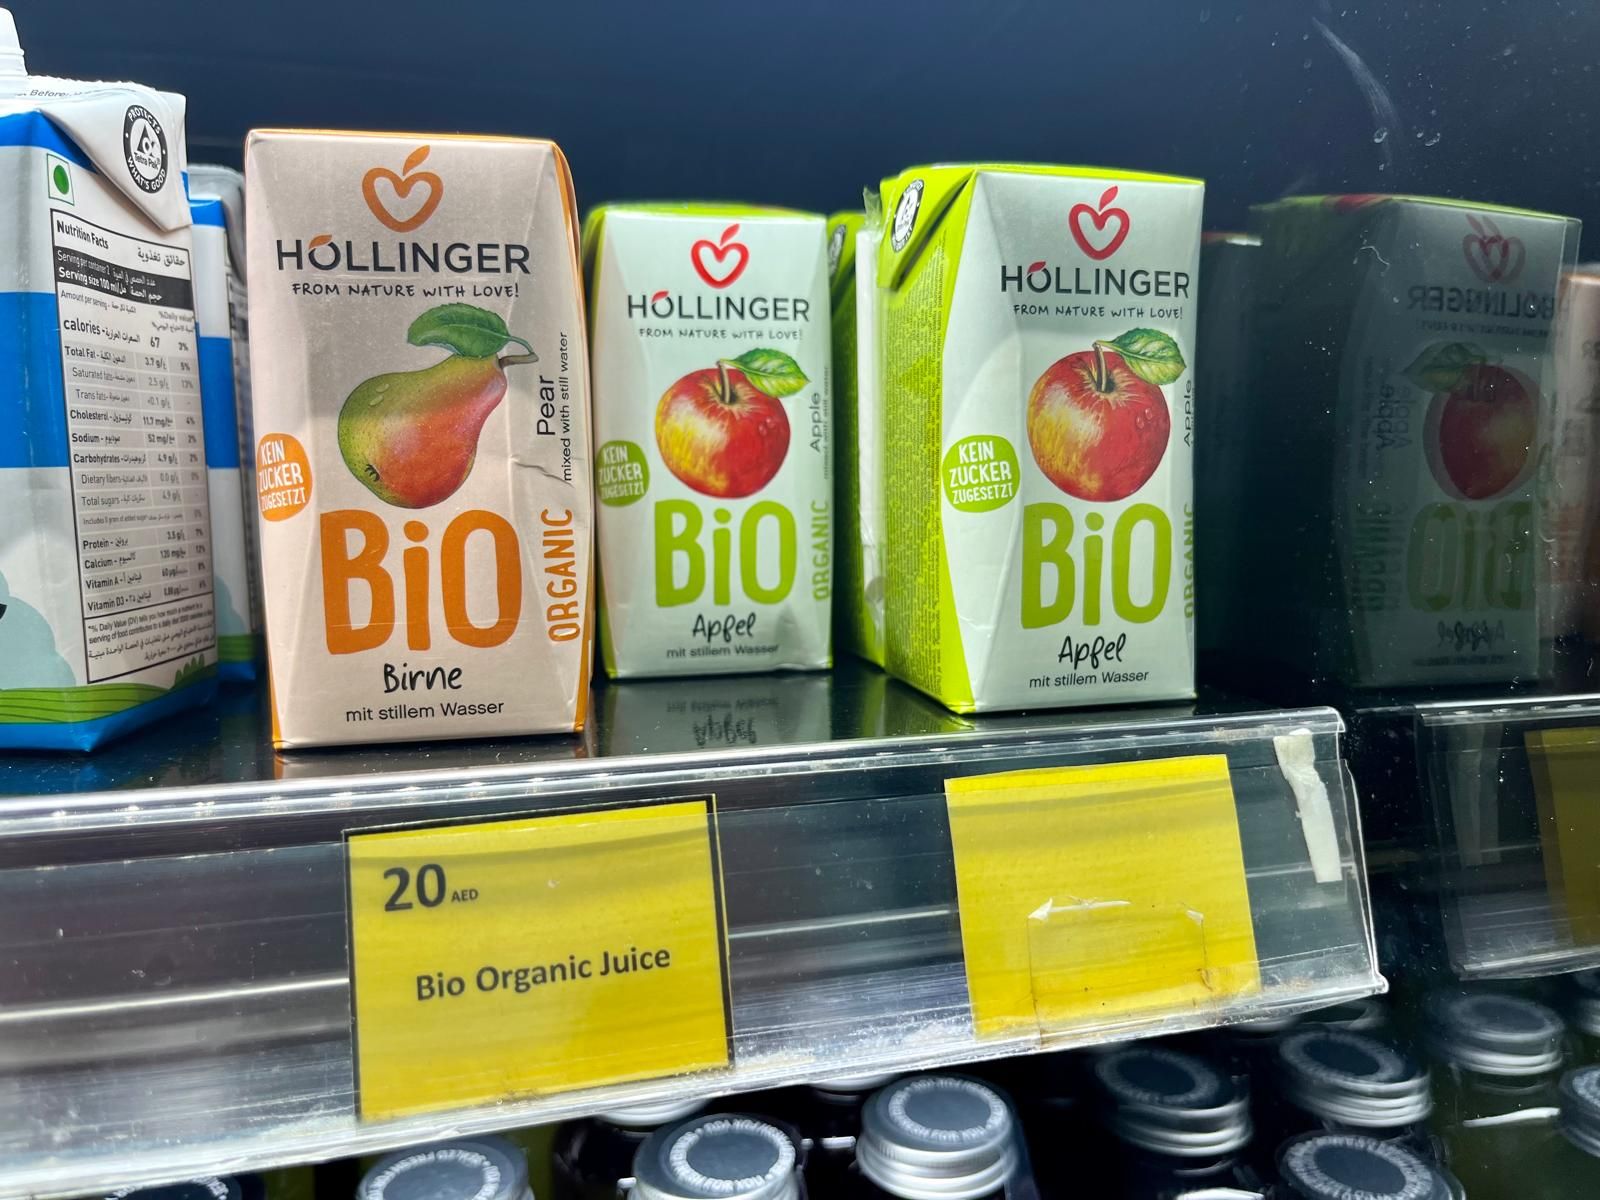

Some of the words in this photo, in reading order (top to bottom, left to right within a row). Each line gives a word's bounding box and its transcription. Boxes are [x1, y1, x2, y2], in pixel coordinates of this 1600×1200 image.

[128, 107, 161, 134] PROTECTS
[128, 156, 150, 190] WHAT'S
[150, 168, 166, 190] GOOD
[57, 219, 91, 243] Nutrition
[91, 232, 109, 249] Facts
[57, 249, 80, 268] Serving
[58, 266, 88, 286] Serving
[60, 289, 84, 302] Amount
[292, 282, 340, 296] FROM
[349, 284, 415, 298] NATURE
[423, 285, 466, 298] WITH
[472, 283, 519, 298] LOVE!
[1013, 304, 1049, 315] FROM
[1055, 305, 1105, 317] NATURE
[1111, 307, 1144, 318] WITH
[1150, 307, 1183, 319] LOVE!
[63, 317, 101, 336] calories
[639, 328, 673, 338] FROM
[678, 328, 727, 339] NATURE
[732, 329, 763, 339] WITH
[64, 345, 86, 357] Total
[150, 336, 160, 348] 67
[560, 332, 568, 373] water
[75, 388, 95, 400] Trans
[559, 376, 570, 400] still
[536, 375, 555, 435] Pear
[1183, 380, 1192, 447] Apple
[560, 404, 570, 435] with
[809, 392, 823, 453] Apple
[71, 432, 99, 443] Sodium
[73, 453, 120, 465] Carbohydrates
[261, 439, 285, 464] KEIN
[561, 437, 572, 481] mixed
[602, 445, 629, 463] KEIN
[958, 440, 994, 464] KEIN
[81, 473, 105, 486] Dietary
[258, 463, 303, 493] ZUCKER
[599, 463, 643, 485] ZUCKER
[949, 462, 1012, 488] ZUCKER
[81, 495, 100, 506] Total
[261, 487, 306, 512] ZUGESETZT
[952, 482, 1013, 505] ZUGESETZT
[82, 539, 109, 550] Protein
[810, 500, 831, 601] ORGANIC
[84, 558, 113, 569] Calcium
[85, 577, 113, 589] Vitamin
[540, 508, 581, 642] ORGANIC
[87, 598, 115, 611] Vitamin
[115, 595, 124, 607] D3
[88, 633, 111, 644] serving
[692, 612, 757, 644] Apfel
[666, 647, 686, 659] mit
[690, 645, 731, 657] stillem
[735, 643, 780, 656] Wasser
[1058, 633, 1126, 670] Apfel
[383, 662, 463, 693] Birne
[1029, 674, 1050, 688] mit
[1054, 673, 1097, 687] stillem
[1101, 671, 1149, 684] Wasser
[346, 706, 373, 722] mit
[378, 704, 435, 720] stillem
[440, 700, 504, 717] Wasser
[382, 863, 447, 913] 20
[451, 888, 479, 902] AED
[416, 973, 465, 1001] Bio
[476, 955, 592, 993] Organic
[600, 947, 671, 976] Juice
